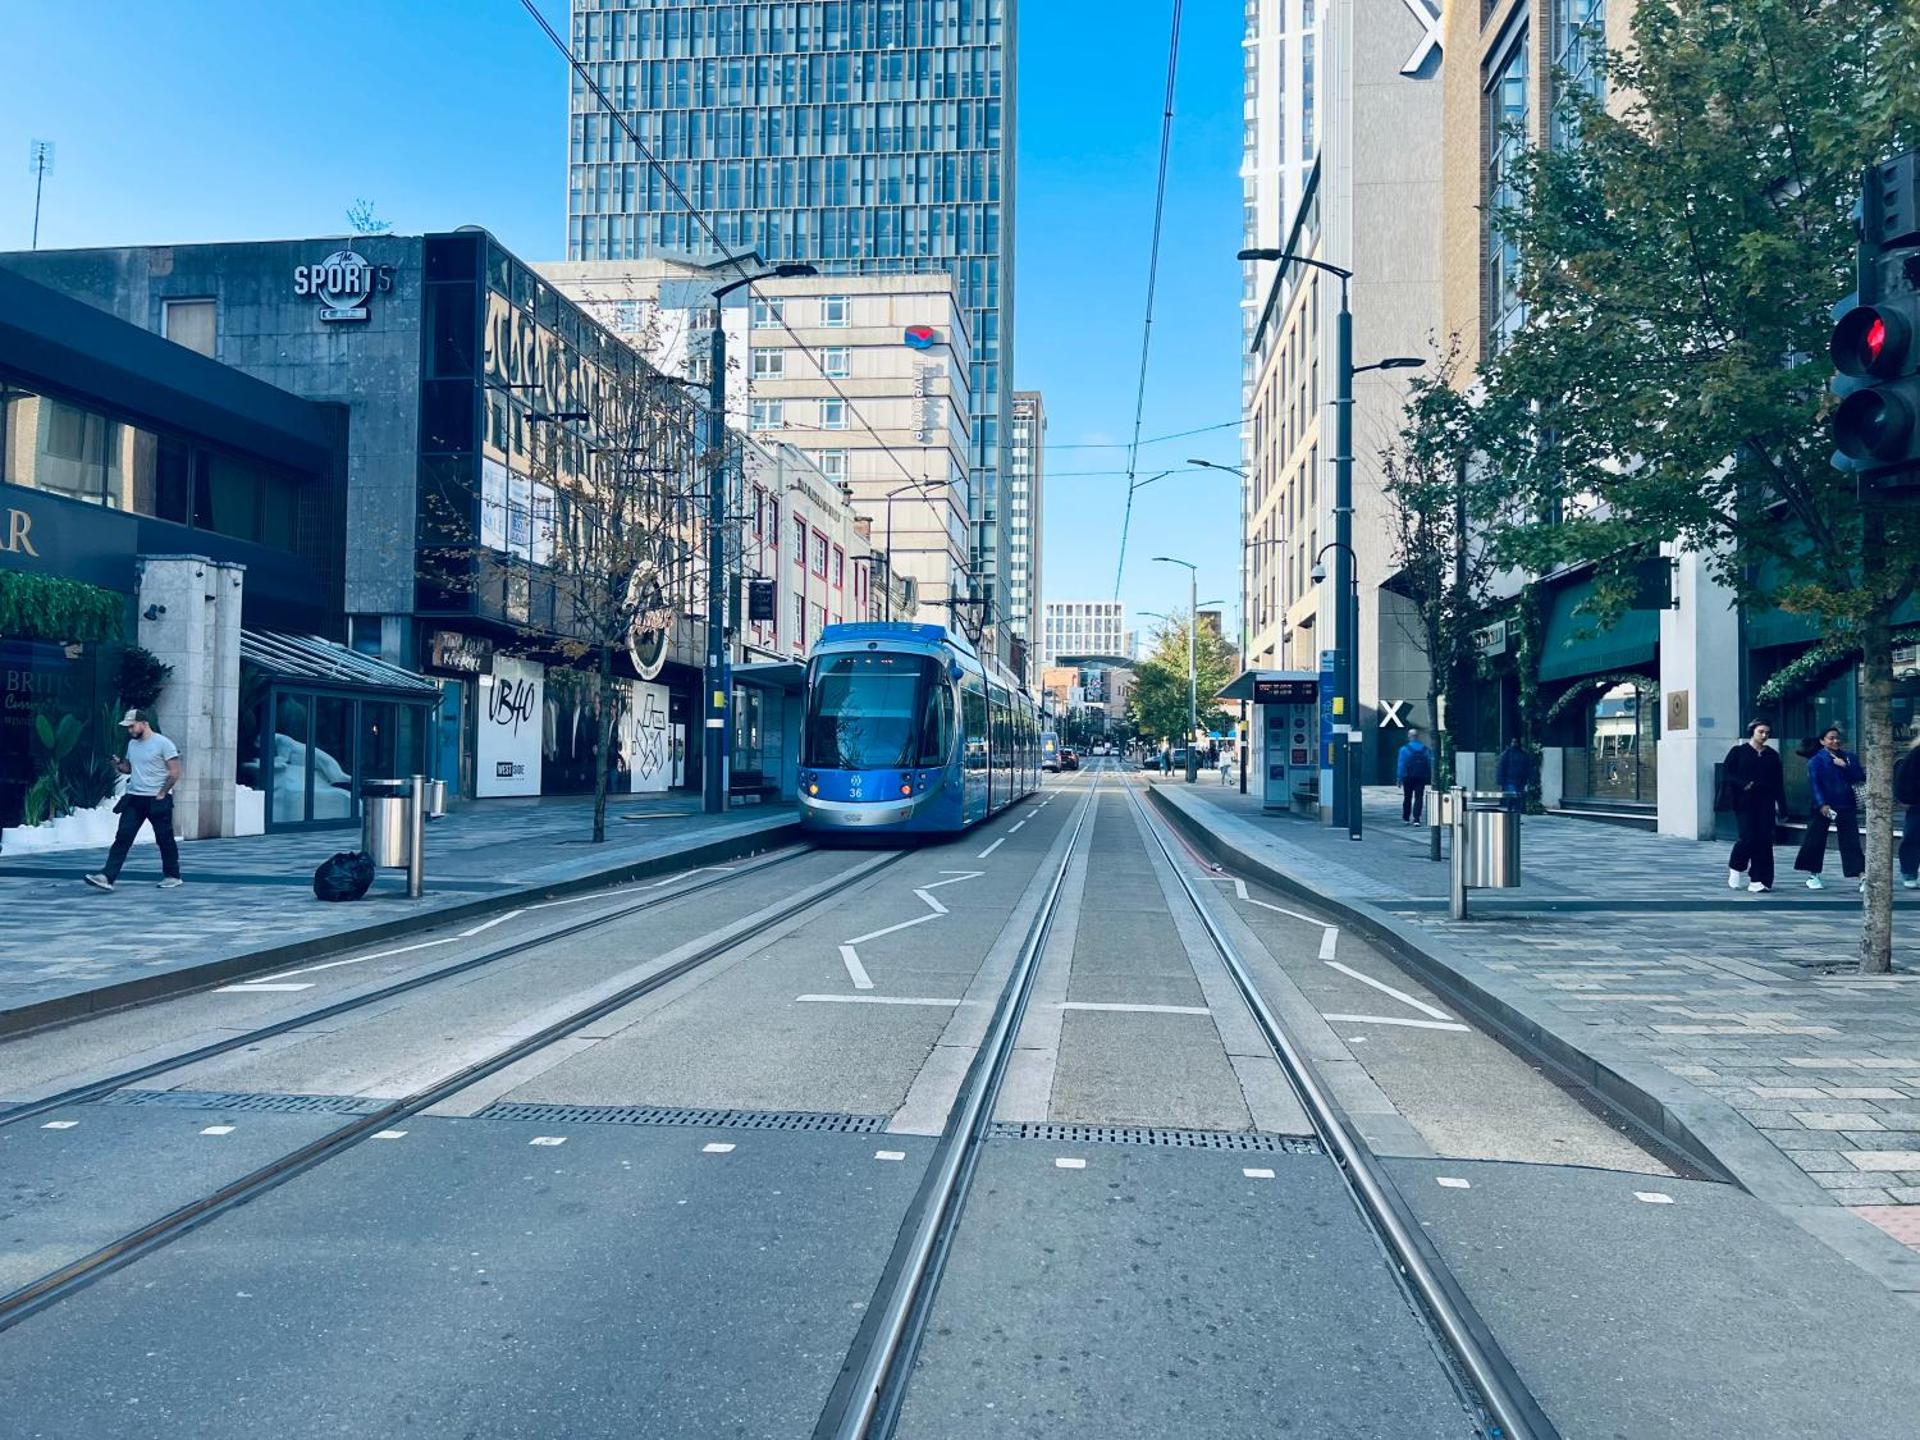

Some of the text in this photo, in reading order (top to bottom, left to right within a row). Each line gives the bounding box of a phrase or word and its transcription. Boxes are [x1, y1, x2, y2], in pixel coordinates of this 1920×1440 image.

[336, 251, 353, 262] The
[294, 264, 394, 295] SPORTS
[0, 508, 39, 557] R
[489, 673, 534, 738] UB40
[1379, 700, 1404, 727] X
[849, 788, 863, 798] 36
